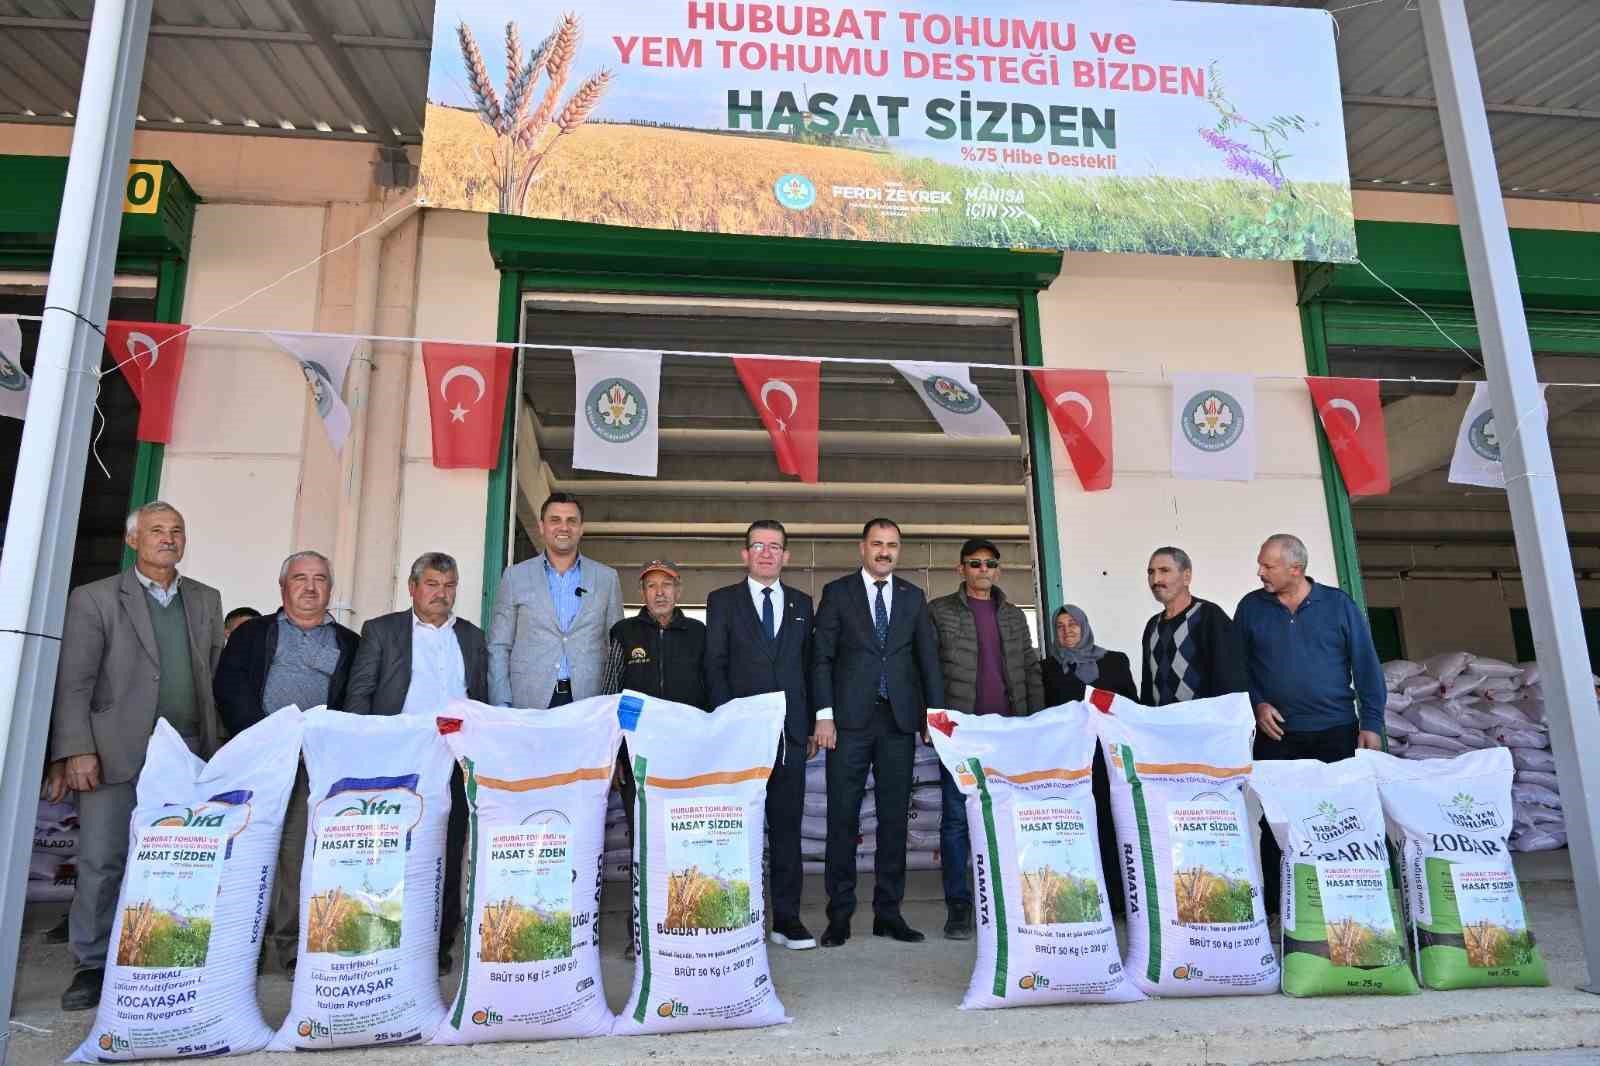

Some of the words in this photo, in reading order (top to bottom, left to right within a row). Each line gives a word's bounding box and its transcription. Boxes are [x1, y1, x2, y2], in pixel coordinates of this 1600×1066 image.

[688, 1, 886, 41] HUBUBAT
[899, 11, 1076, 51] TOHUMU
[1089, 31, 1137, 55] ve
[612, 36, 703, 69] YEM
[716, 40, 889, 77] TOHUMU
[903, 50, 1060, 87] DESTEĞİ
[1072, 57, 1205, 97] BİZDEN
[727, 89, 909, 137] HASAT
[925, 90, 1117, 149] SİZDEN
[960, 146, 997, 163] %75
[1003, 150, 1043, 165] Hibe
[1048, 151, 1117, 170] Destekli
[671, 821, 704, 832] HASAT
[708, 819, 743, 831] SİZDEN
[1020, 822, 1053, 832] HASAT
[1055, 819, 1085, 832] SİZDEN
[1316, 823, 1361, 841] TOHUMU
[322, 839, 356, 850] HASAT
[1427, 832, 1501, 856] ZOBAR
[137, 851, 171, 860] HASAT
[172, 849, 216, 861] SİZDEN
[491, 849, 525, 861] HASAT
[1124, 844, 1139, 913] RAMATA
[1326, 879, 1354, 888] HASAT
[977, 854, 989, 926] RAMATA
[1035, 944, 1056, 955] BRÜT
[1058, 946, 1068, 955] 50
[1069, 946, 1079, 956] Kg
[1189, 937, 1211, 948] BRÜT
[1213, 940, 1221, 948] 50
[1223, 941, 1233, 950] Kg
[490, 970, 513, 983] BRÜT
[514, 974, 525, 983] 50
[527, 971, 539, 982] Kg
[553, 963, 567, 976] 200
[674, 966, 696, 977] BRÜT
[698, 968, 708, 976] 50
[709, 967, 721, 977] Kg
[733, 959, 745, 971] 200
[315, 976, 395, 998] KOCAYAŞAR
[116, 989, 198, 1009] KOCAYAŞAR
[373, 1032, 389, 1042] 25
[177, 1045, 193, 1055] 25
